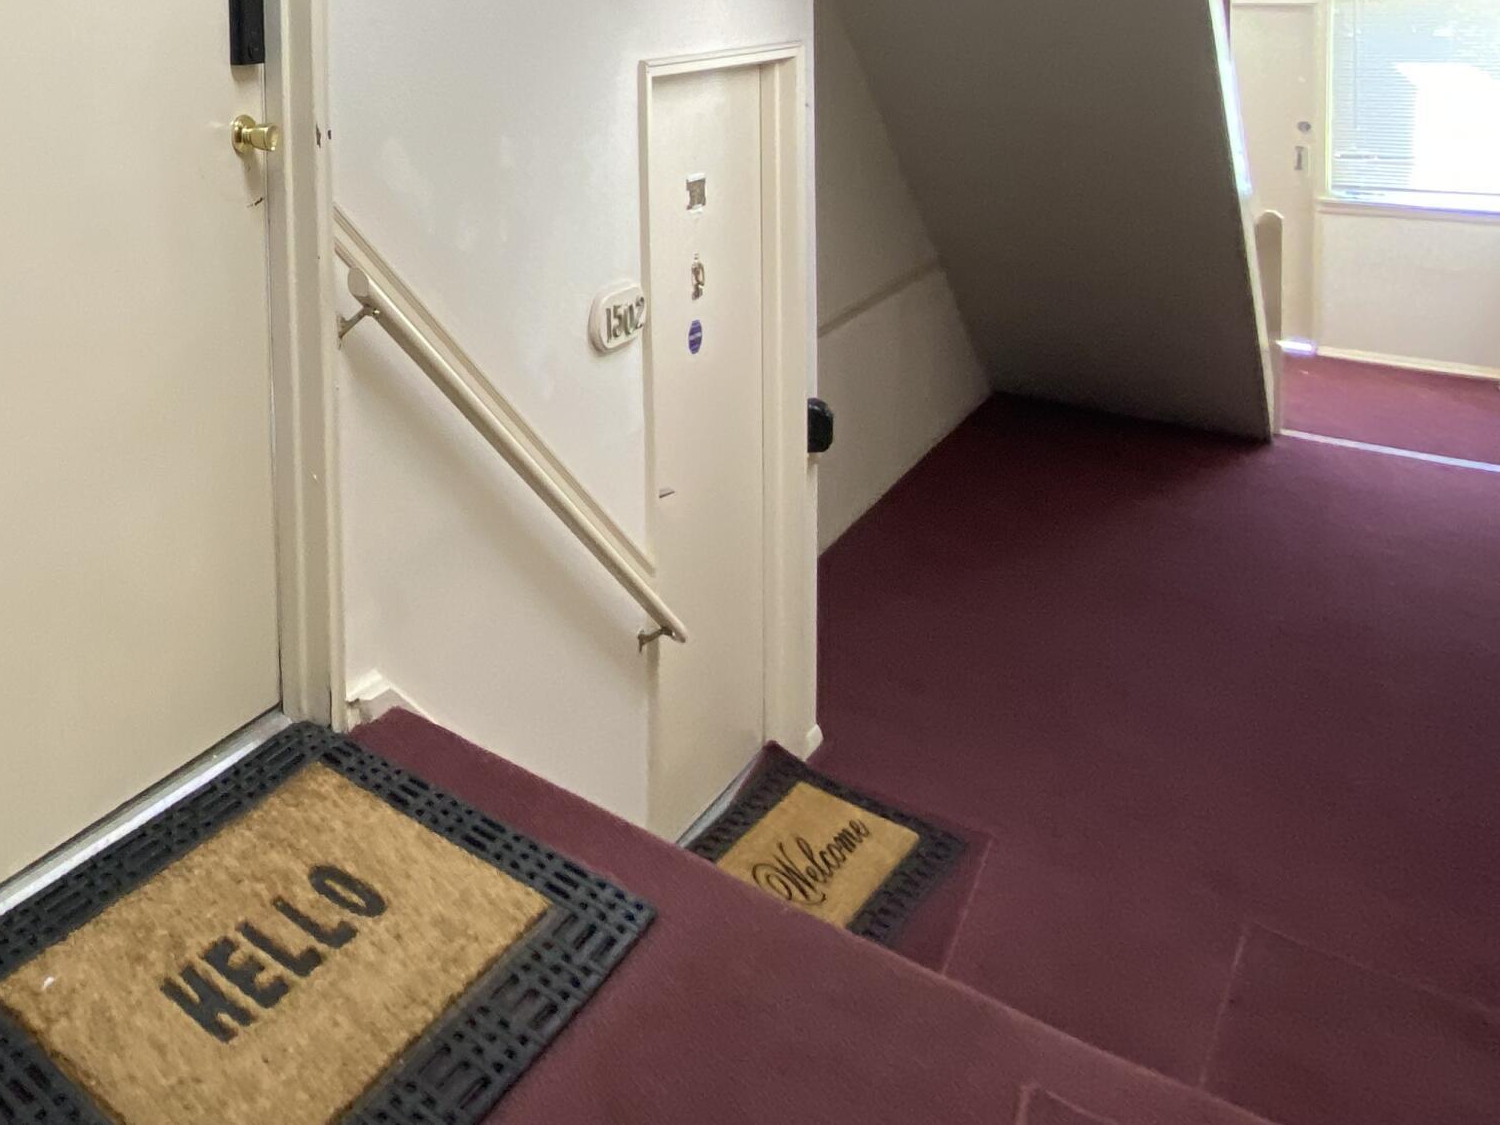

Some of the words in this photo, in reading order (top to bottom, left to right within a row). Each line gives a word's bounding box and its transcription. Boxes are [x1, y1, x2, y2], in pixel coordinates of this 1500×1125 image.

[605, 296, 645, 343] 1502
[752, 820, 870, 905] Welcome
[161, 864, 388, 1043] HELLO
